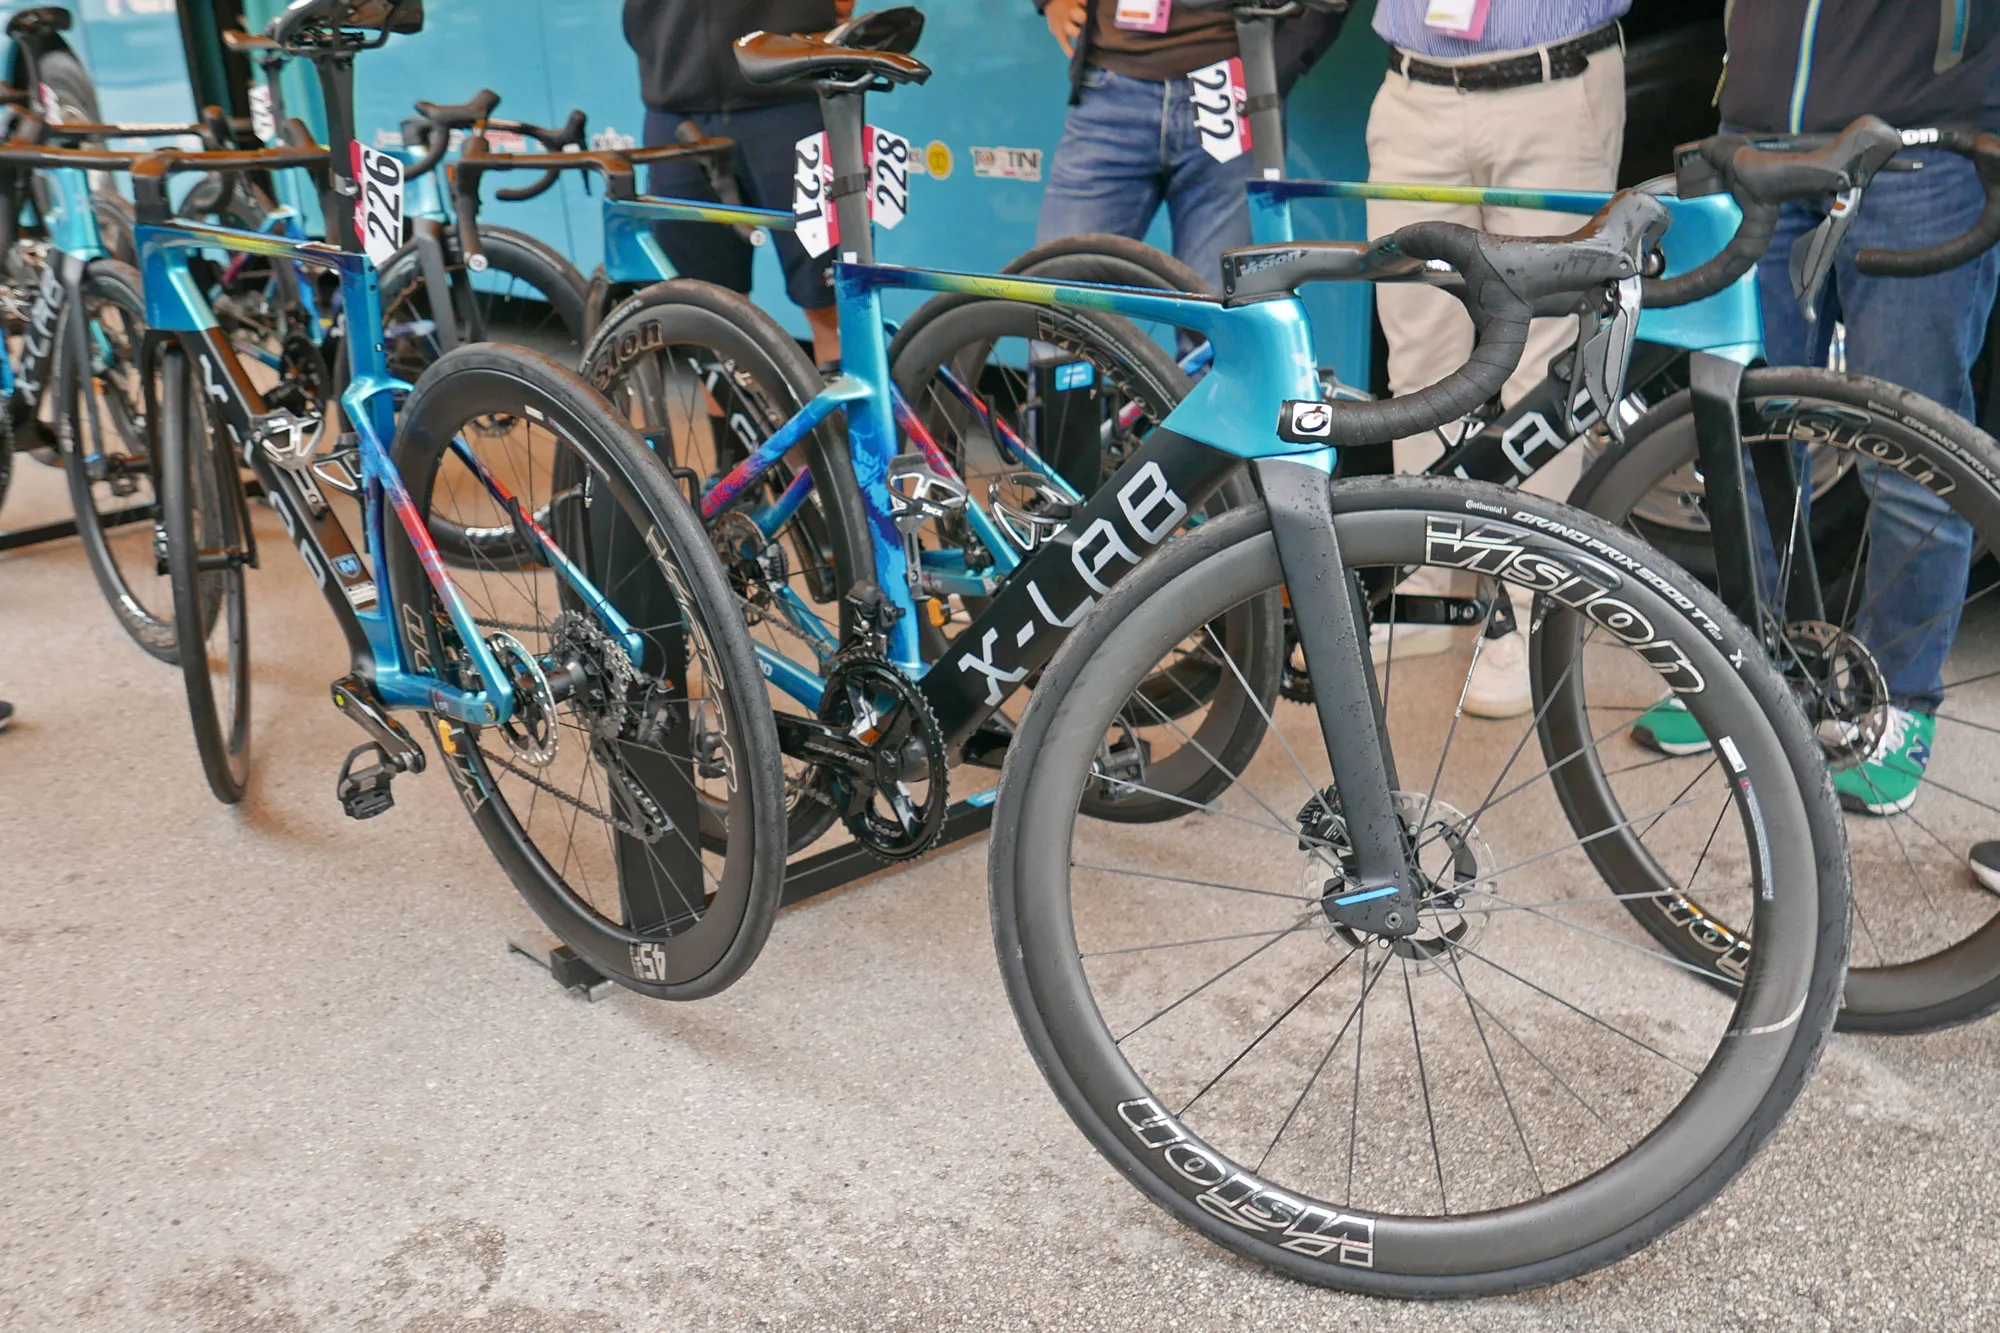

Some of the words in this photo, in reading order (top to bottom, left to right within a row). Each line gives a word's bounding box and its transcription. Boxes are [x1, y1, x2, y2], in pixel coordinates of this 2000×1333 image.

[1188, 68, 1235, 145] 222
[363, 149, 400, 252] 226
[794, 143, 823, 223] 221
[876, 133, 908, 215] 228
[957, 460, 1188, 707] X-LAB
[1512, 510, 1591, 544] GRAND
[1590, 538, 1642, 572] PRIX
[1636, 565, 1695, 611] 5000
